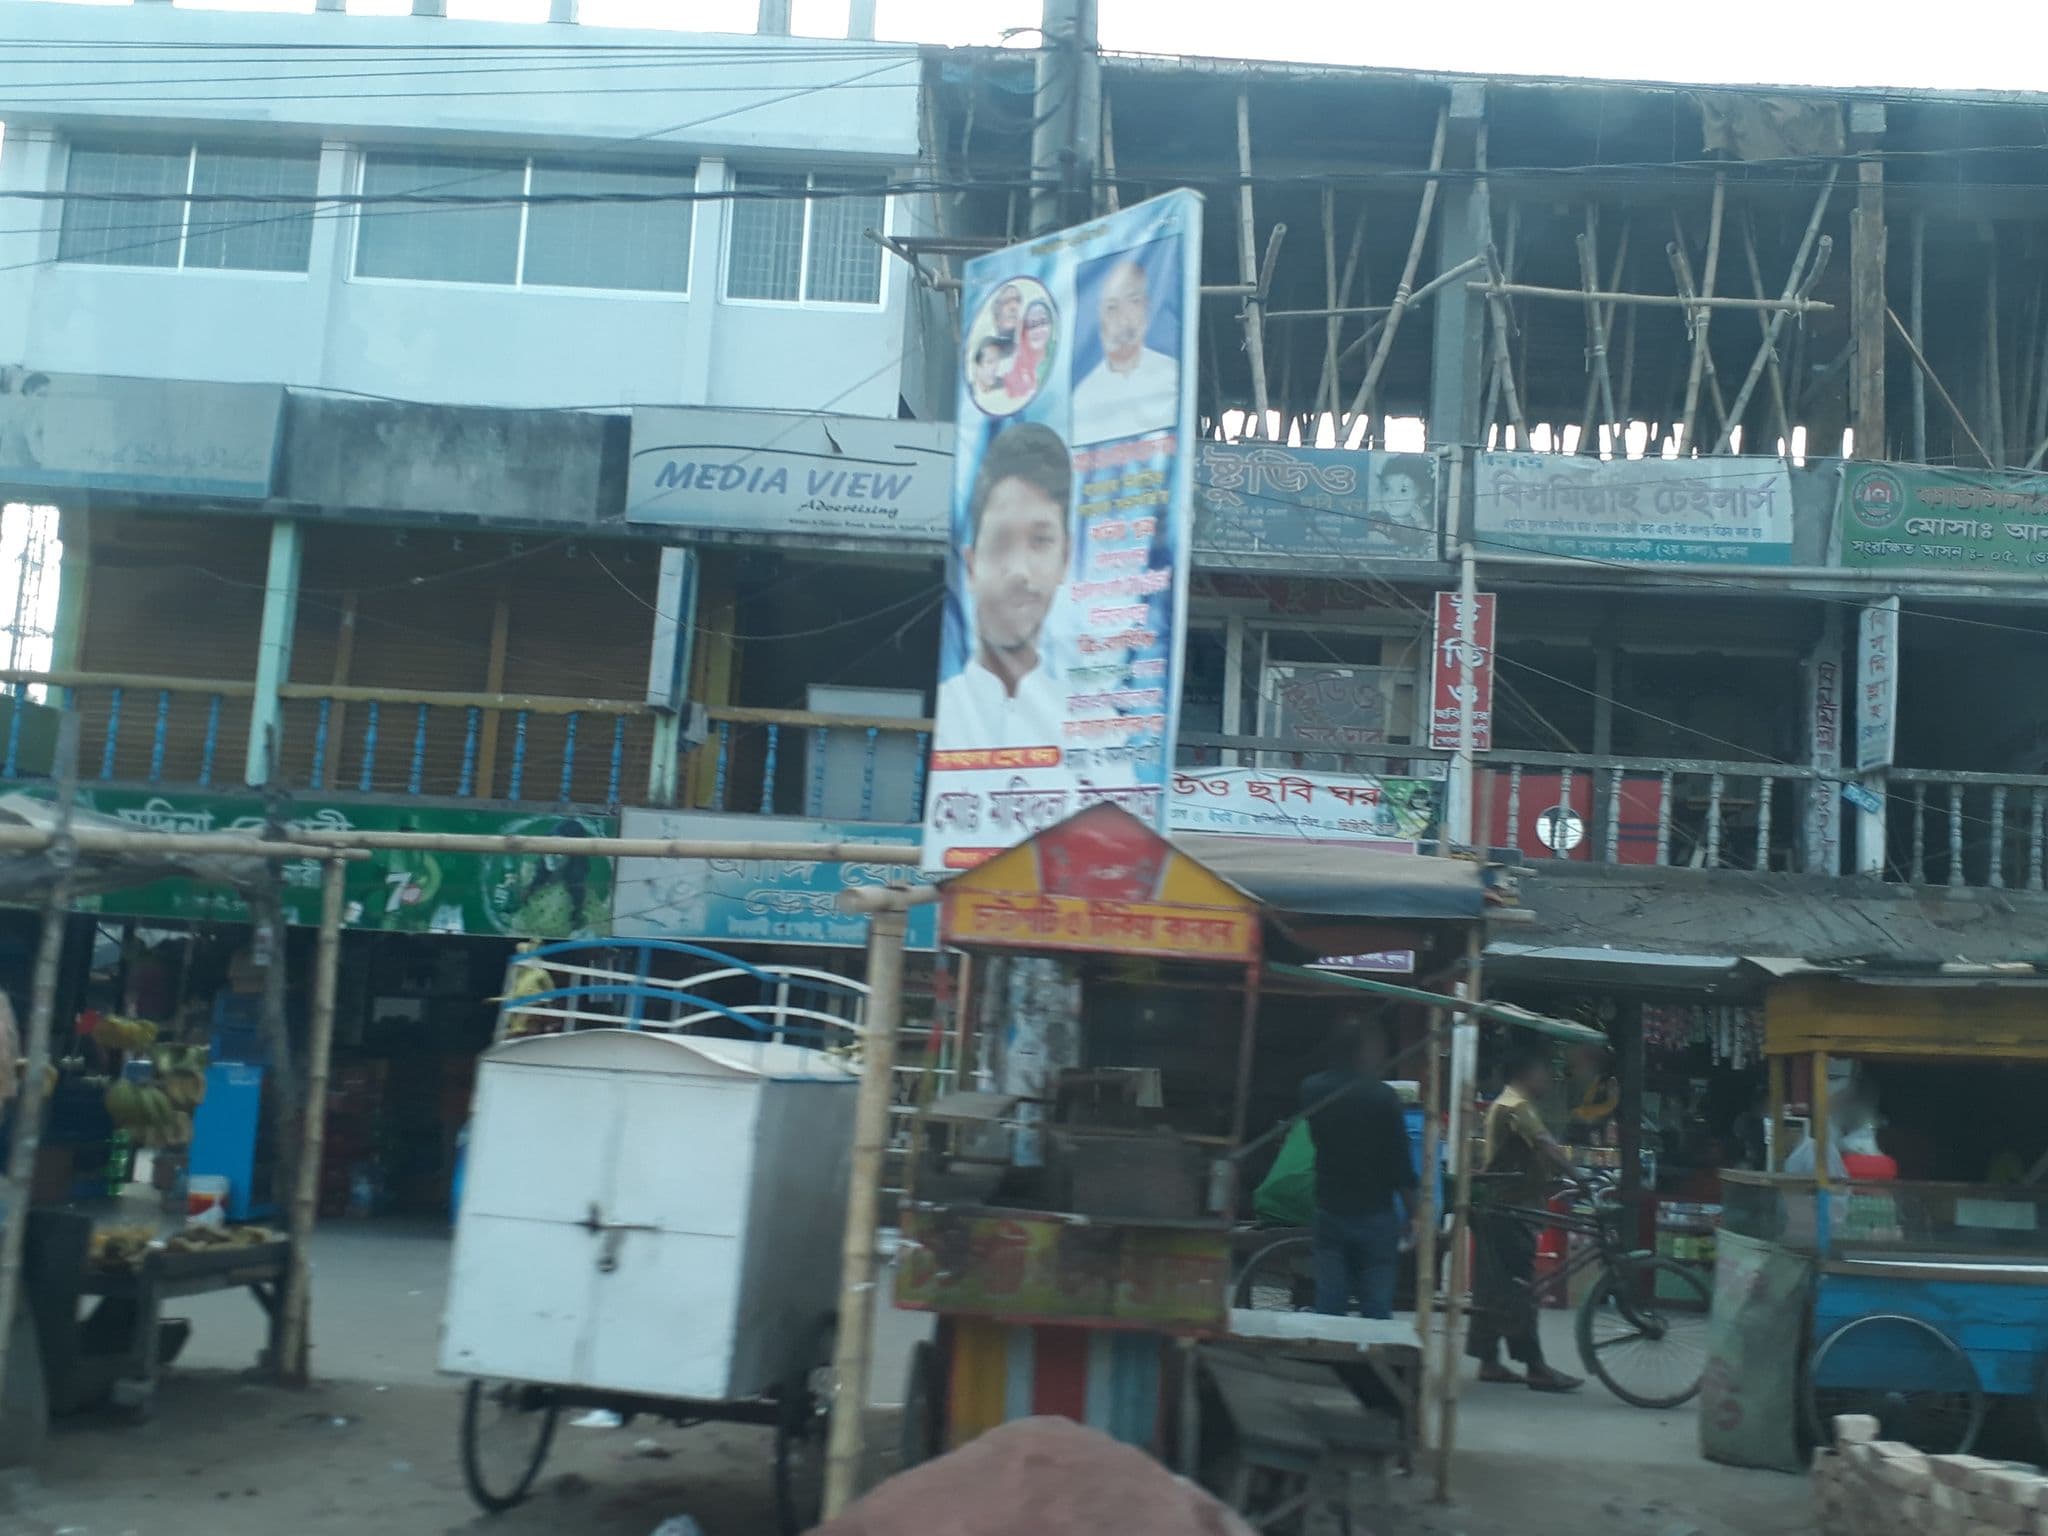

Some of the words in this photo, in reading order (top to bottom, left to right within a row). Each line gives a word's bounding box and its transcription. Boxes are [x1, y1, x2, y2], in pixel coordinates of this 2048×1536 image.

[654, 460, 788, 494] MEDIA
[807, 469, 913, 500] VIEW
[798, 499, 899, 518] Advertising
[1905, 517, 1994, 540] মোসাঃ
[1851, 538, 1915, 558] সংরক্ষিত
[1921, 544, 1963, 560] আসন
[1246, 776, 1315, 804] ছবি
[1328, 785, 1380, 806] ঘর
